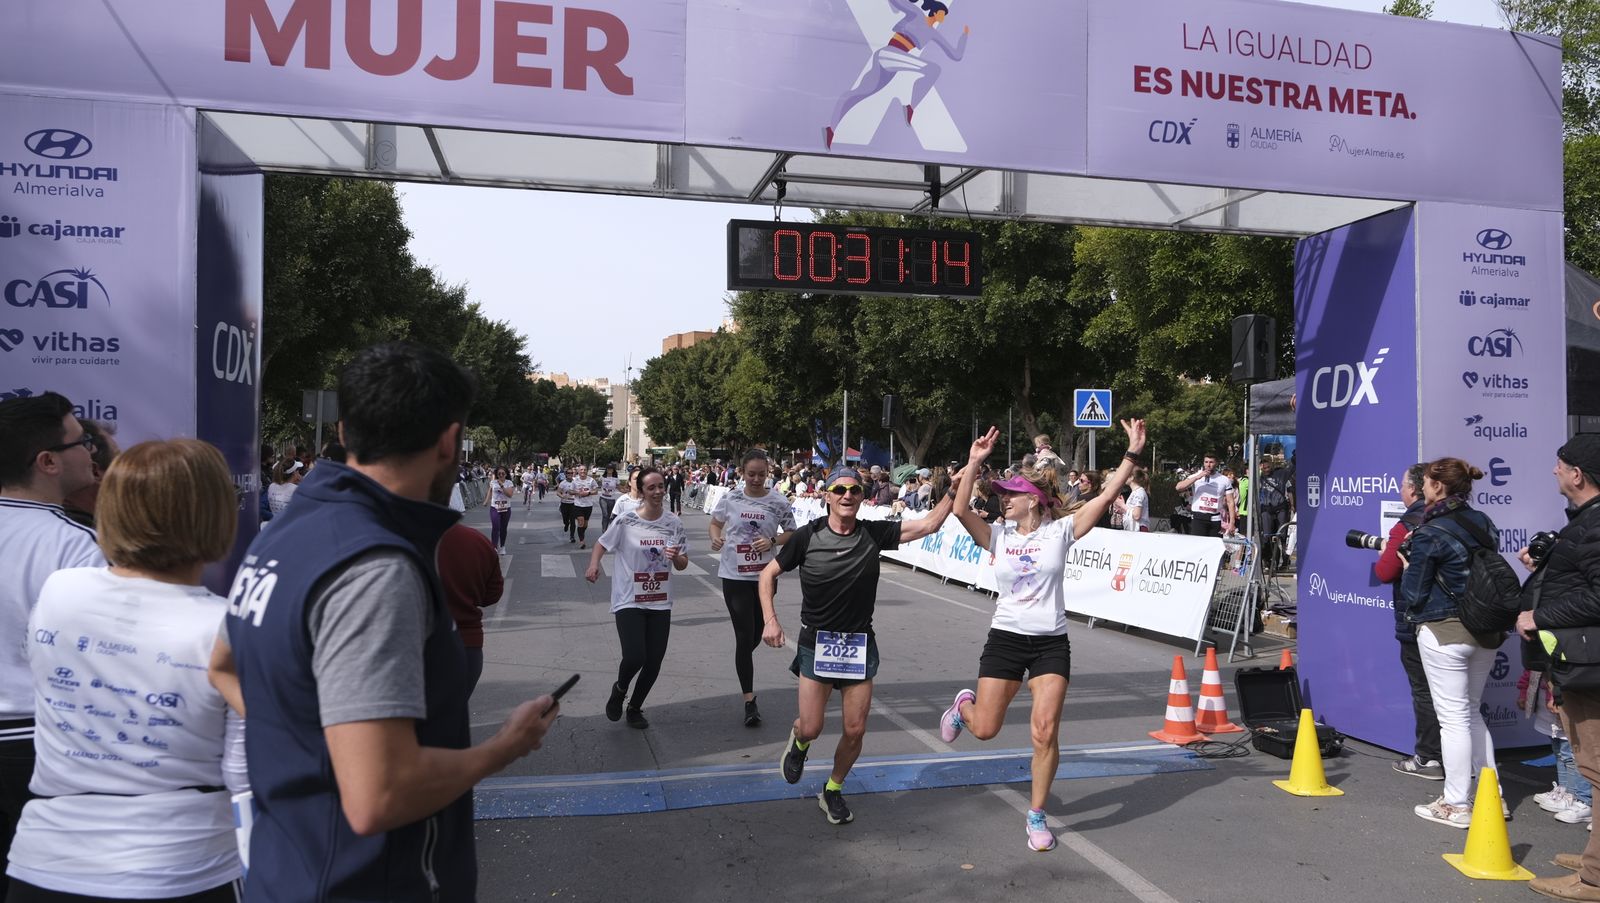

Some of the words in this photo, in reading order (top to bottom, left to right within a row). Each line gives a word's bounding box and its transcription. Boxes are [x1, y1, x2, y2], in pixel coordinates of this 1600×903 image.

[224, 0, 635, 96] MUJER
[1183, 23, 1218, 53] LA
[1228, 28, 1372, 70] IGUALDAD
[1134, 65, 1173, 95] ES
[1181, 70, 1322, 111] NUESTRA
[1328, 86, 1417, 120] META.
[1149, 118, 1198, 145] CDX
[1250, 127, 1303, 143] ALMERÍA
[1250, 140, 1278, 150] CIUDAD
[0, 162, 118, 181] HYUNDAI
[13, 181, 104, 198] Almerialva
[28, 220, 125, 241] cajamar
[1463, 252, 1526, 266] HYUNDAI
[1471, 265, 1519, 278] Almerialva
[4, 279, 88, 309] CASI
[1479, 293, 1531, 309] cajamar
[33, 332, 120, 353] vithas
[1468, 335, 1512, 358] CASI
[32, 356, 54, 364] vivir
[55, 357, 78, 366] para
[79, 356, 120, 366] cuidarte
[212, 321, 256, 385] CDX
[1311, 347, 1389, 410] CDX
[1483, 374, 1529, 390] vithas
[72, 399, 119, 421] alia
[1473, 423, 1528, 441] aqualia
[1331, 473, 1399, 493] ALMERÍA
[1331, 494, 1364, 507] CIUDAD
[1477, 492, 1513, 505] Clece
[740, 512, 766, 520] MUJER
[744, 552, 762, 562] 601
[949, 534, 983, 565] NEXA
[1065, 547, 1112, 572] LMERÍA
[1063, 568, 1083, 581] UDAD
[1140, 557, 1209, 584] ALMERÍA
[642, 581, 661, 591] 602
[1138, 579, 1173, 596] CIUDAD
[822, 644, 858, 659] 2022
[146, 694, 179, 709] CASI
